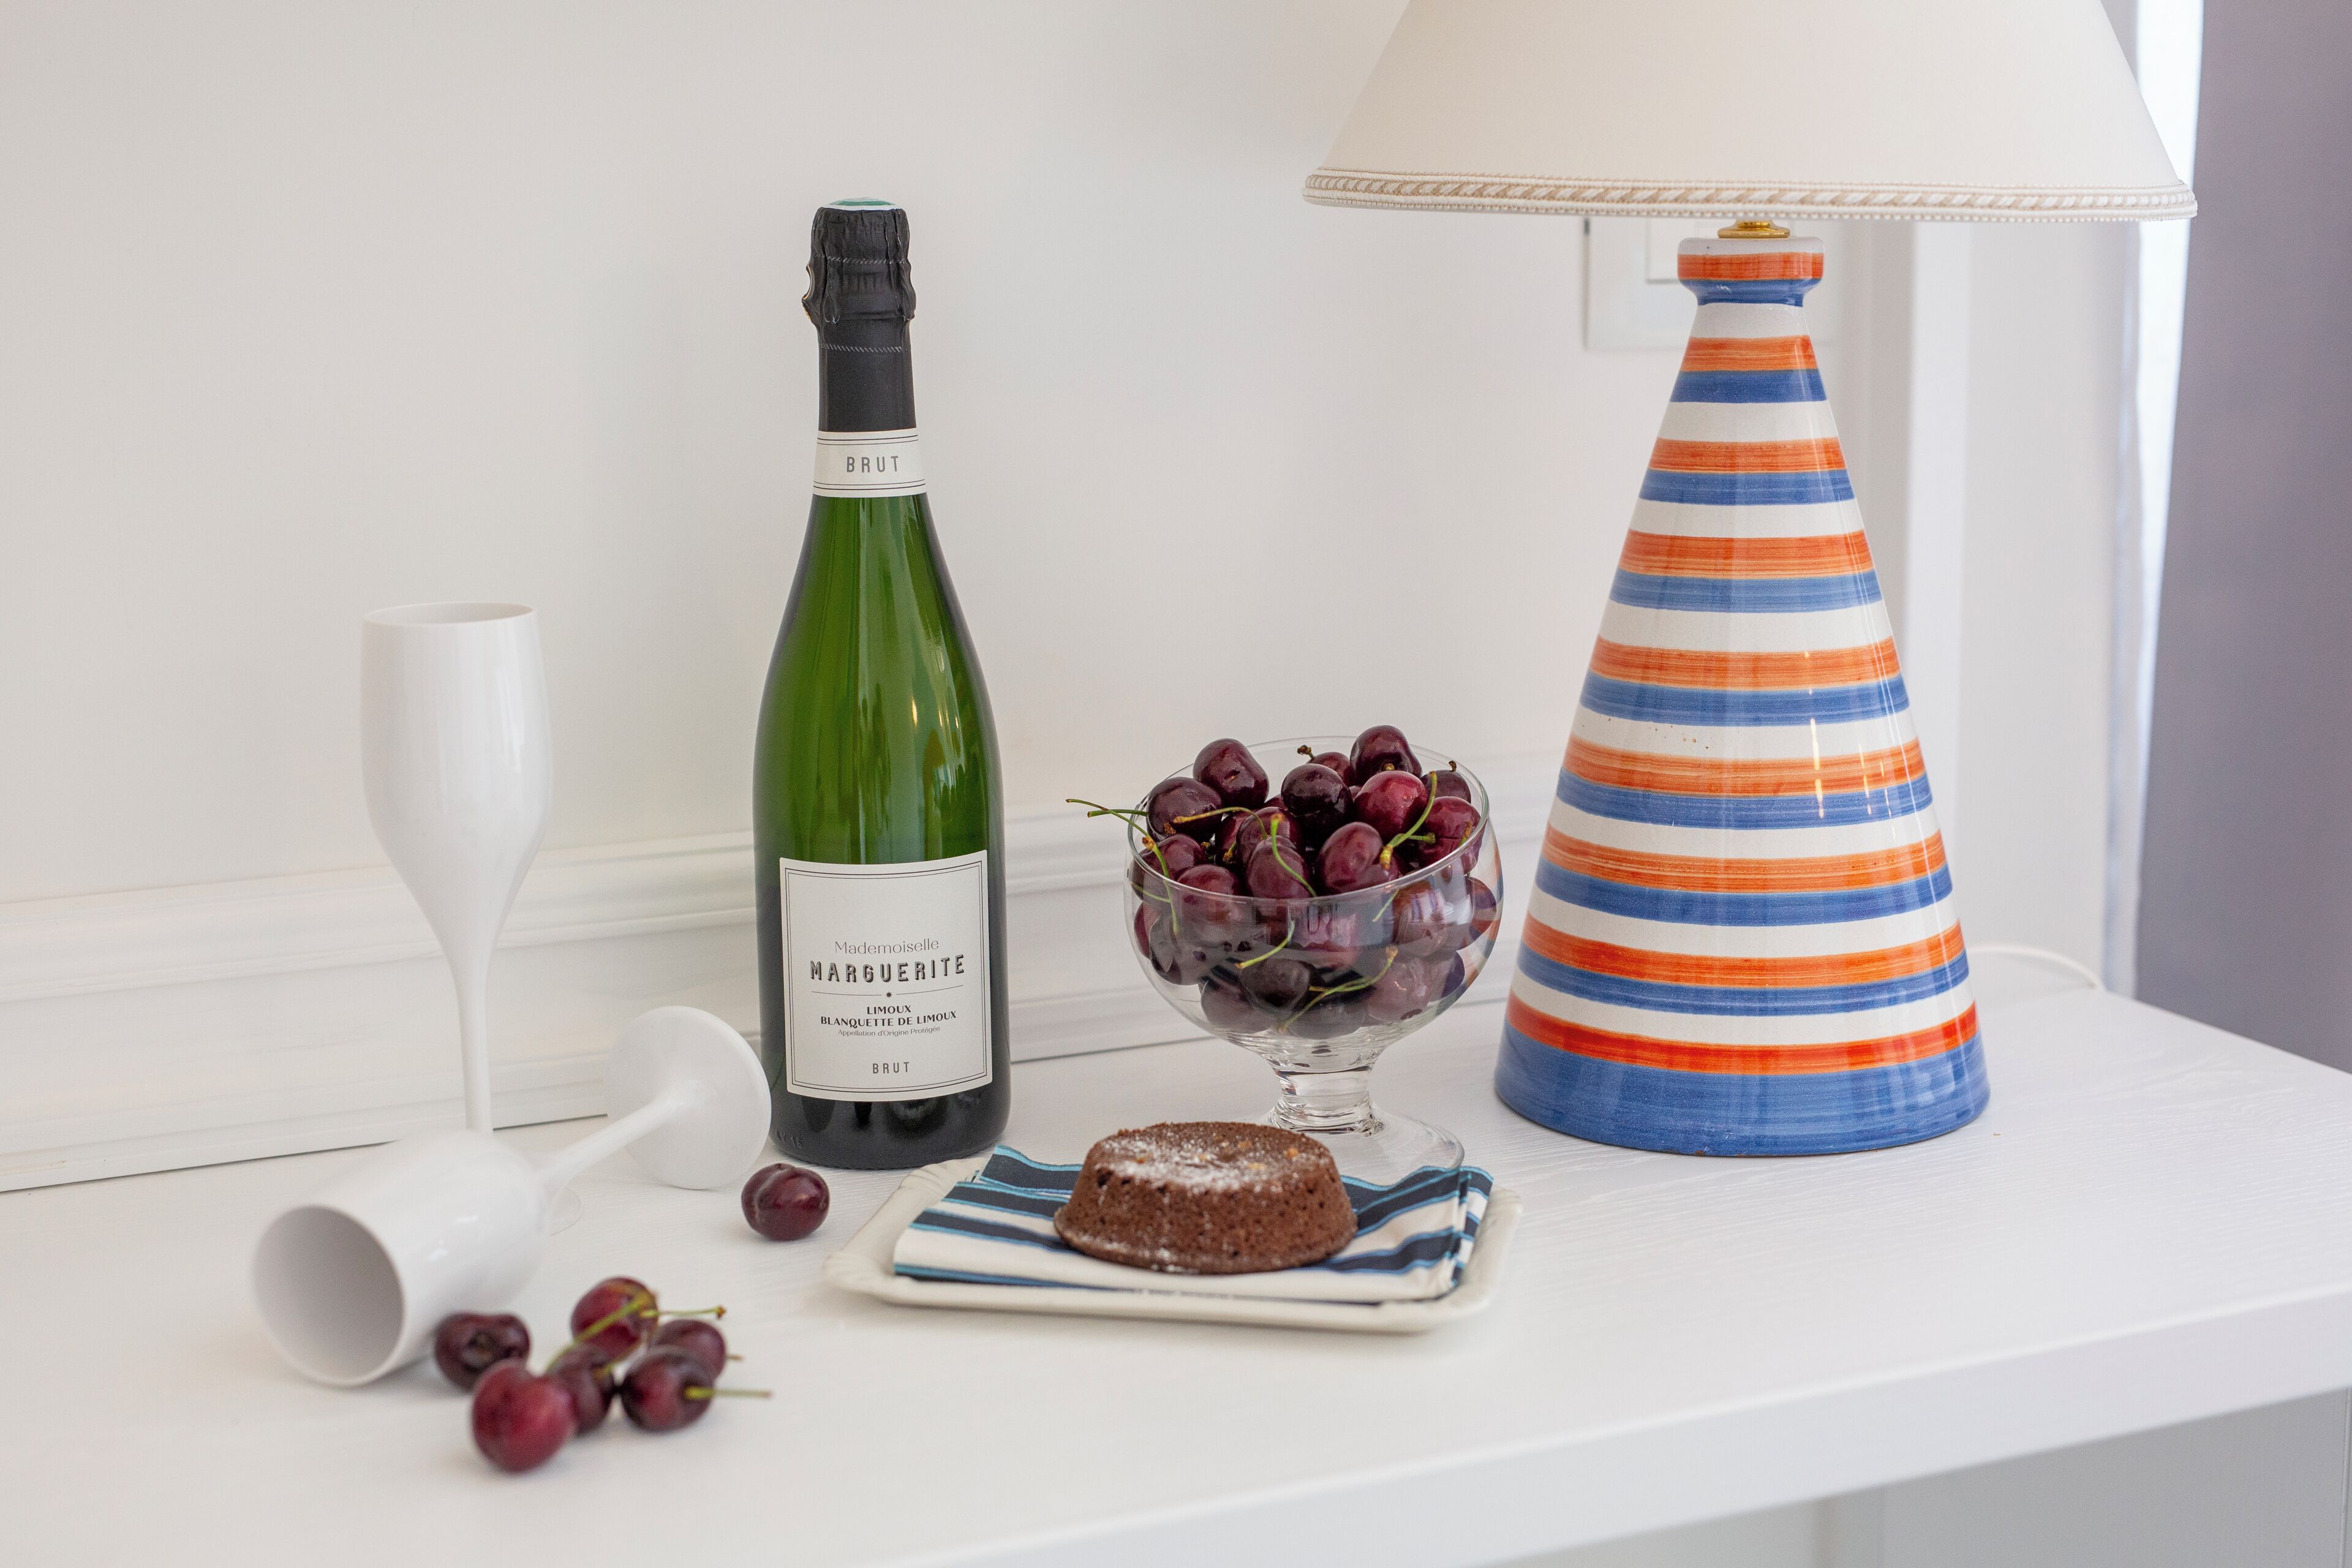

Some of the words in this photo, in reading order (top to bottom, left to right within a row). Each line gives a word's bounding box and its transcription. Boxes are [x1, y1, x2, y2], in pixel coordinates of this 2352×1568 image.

[846, 455, 899, 473] BRUT
[834, 938, 939, 954] Mademoiselle
[810, 954, 965, 983] MARGUERITE
[866, 1005, 911, 1015] LIMOUX
[820, 1016, 894, 1028] BLANQUETTE
[897, 1016, 913, 1026] DE
[916, 1010, 957, 1025] LIMOUX
[877, 1028, 909, 1038] d'Origine
[910, 1025, 941, 1035] Protégée
[872, 1061, 910, 1074] BRUT
